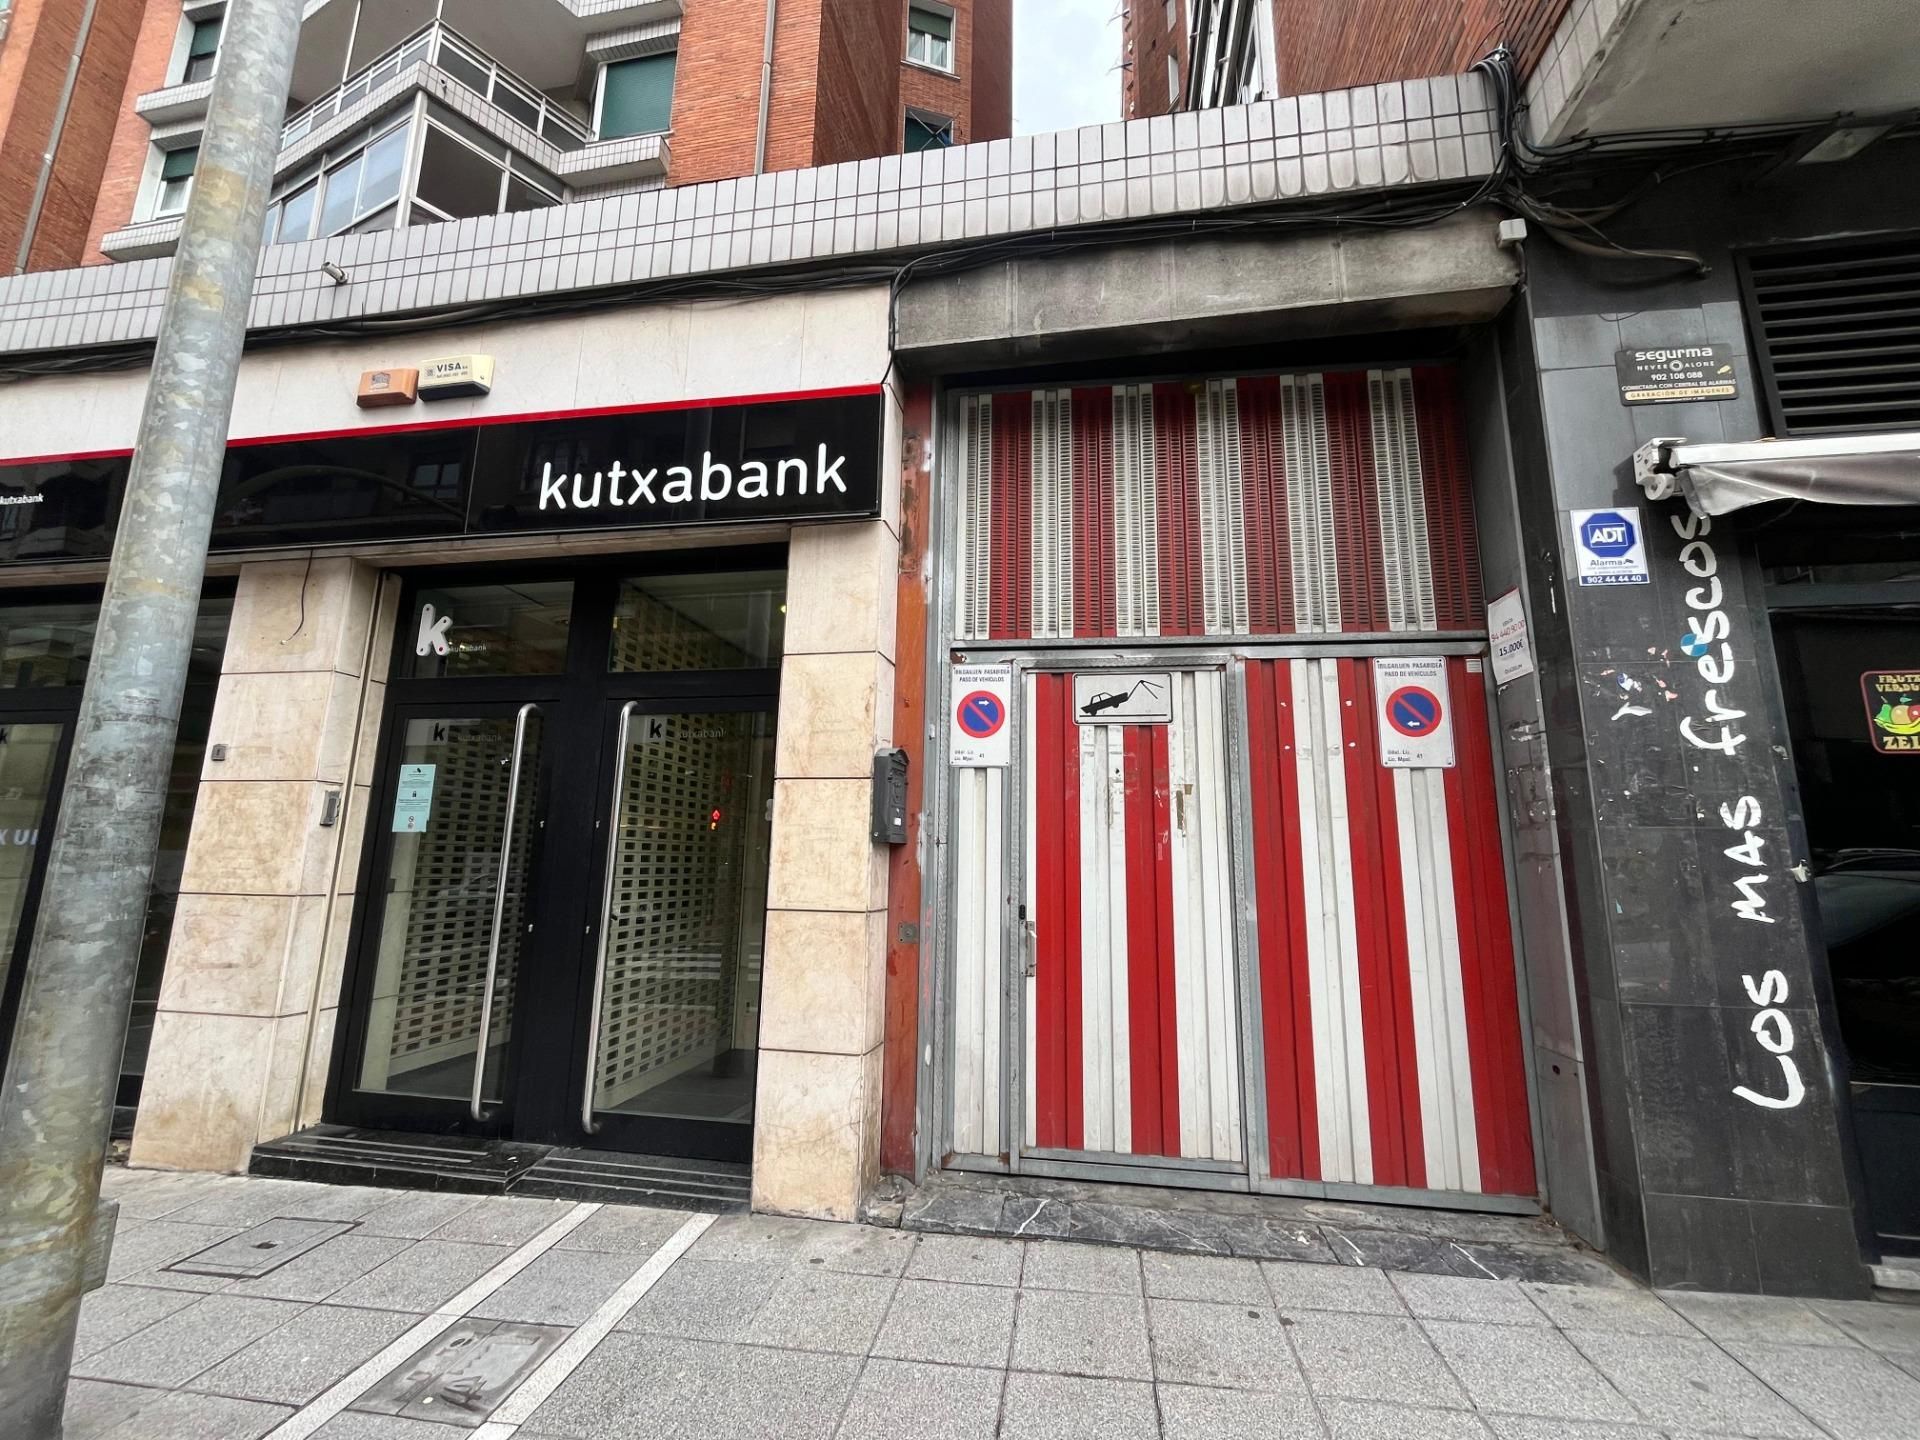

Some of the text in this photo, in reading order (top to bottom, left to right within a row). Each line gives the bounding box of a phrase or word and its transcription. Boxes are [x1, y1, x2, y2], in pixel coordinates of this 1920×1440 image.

[1635, 347, 1713, 362] segurma
[437, 362, 461, 372] VISA
[1651, 373, 1667, 381] 902
[539, 443, 847, 510] kutxabank
[1590, 526, 1626, 544] ADT
[1590, 558, 1623, 566] Alarma
[1587, 576, 1603, 584] 902
[416, 603, 453, 656] k
[650, 718, 662, 738] k
[1719, 795, 1775, 924] MAS
